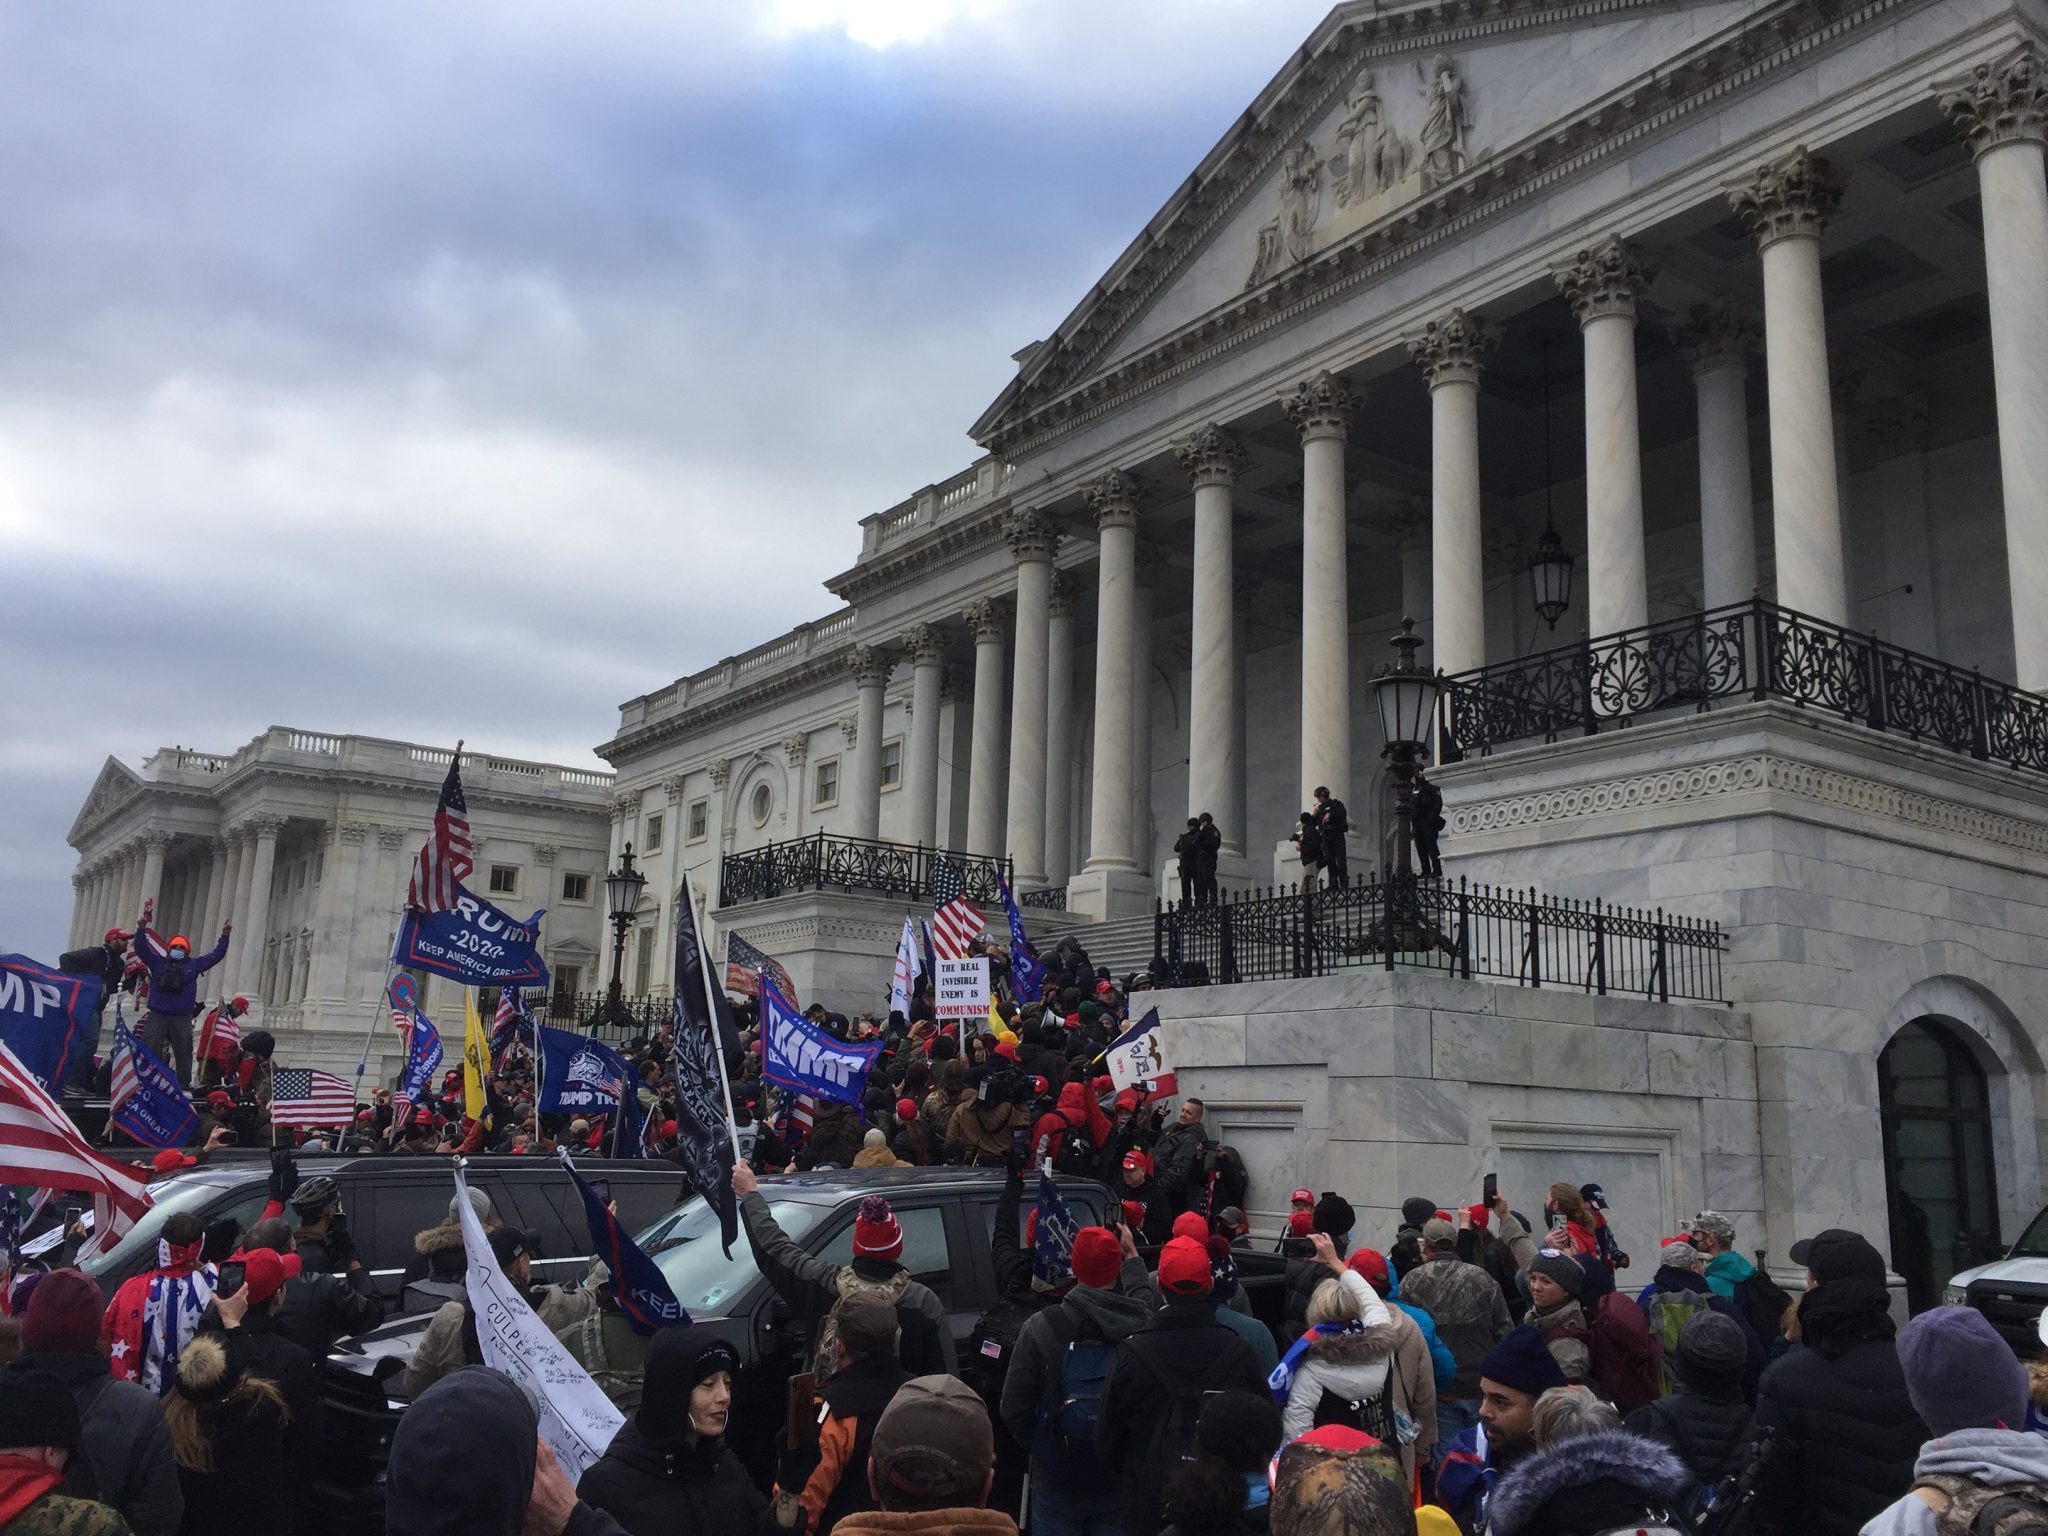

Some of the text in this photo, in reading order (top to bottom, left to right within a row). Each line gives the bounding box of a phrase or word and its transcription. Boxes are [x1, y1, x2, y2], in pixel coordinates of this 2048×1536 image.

[418, 939, 445, 956] KEEP
[446, 950, 491, 975] AMERICA
[941, 962, 980, 973] THE REAL
[942, 976, 978, 986] INVISIBLE
[941, 989, 979, 999] ENEMY IS
[935, 1005, 990, 1016] COMMUNISM
[487, 1302, 533, 1355] CULPE
